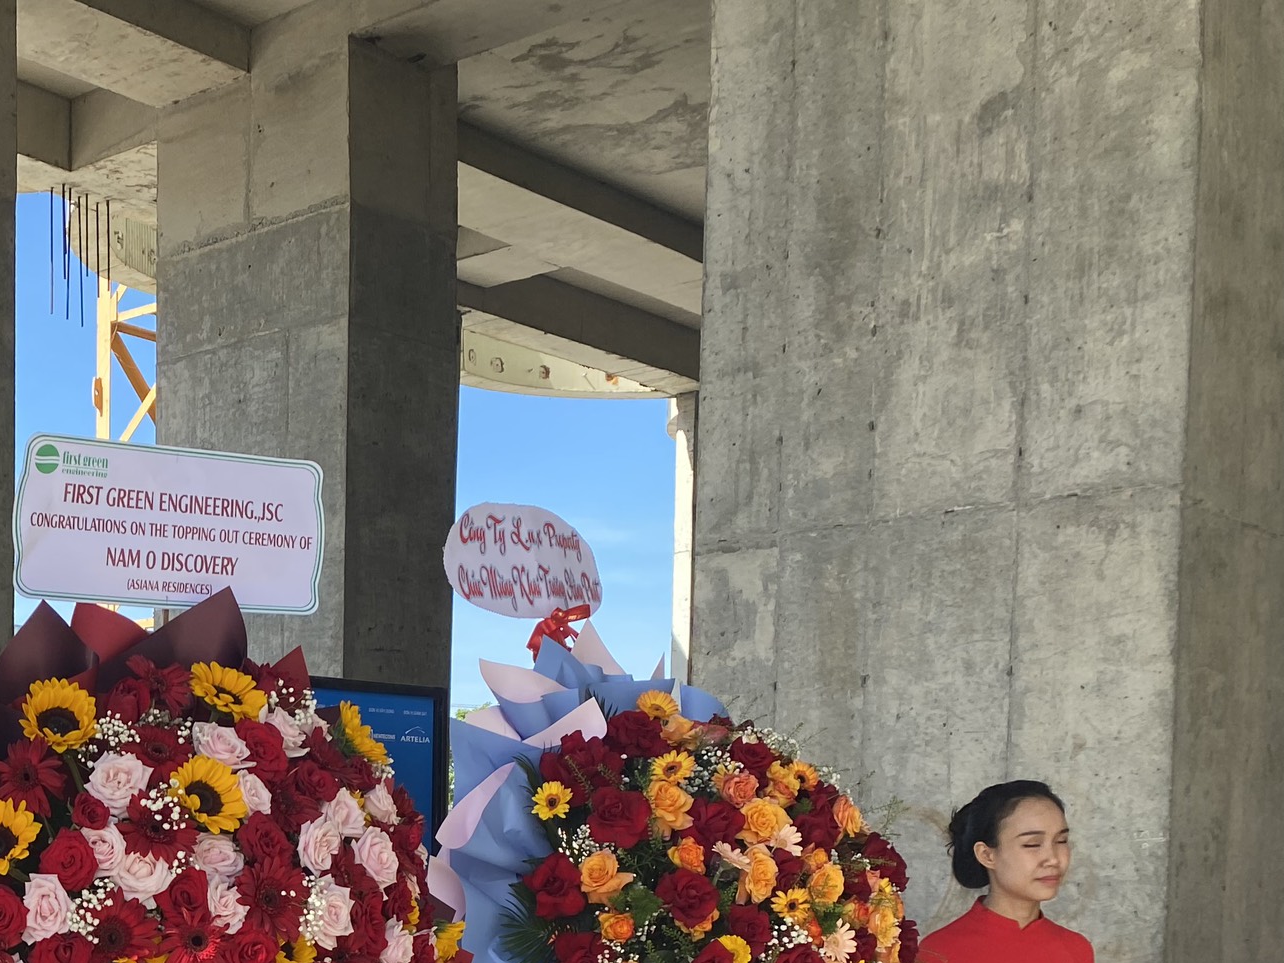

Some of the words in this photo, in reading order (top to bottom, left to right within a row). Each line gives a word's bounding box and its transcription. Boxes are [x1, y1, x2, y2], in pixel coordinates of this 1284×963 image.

[62, 450, 82, 466] first
[83, 455, 109, 469] green
[61, 467, 109, 478] engineering
[63, 482, 104, 506] FIRST
[106, 488, 155, 511] GREEN
[29, 511, 128, 535] CONGRATULATIONS
[129, 520, 147, 537] ON
[148, 522, 169, 538] THE
[171, 524, 217, 543] TOPPING
[219, 527, 241, 545] OUT
[242, 530, 299, 550] CEREMONY
[299, 536, 313, 551] OF
[486, 514, 506, 556] Ty
[105, 546, 142, 569] NAM
[145, 550, 157, 571] O
[160, 551, 240, 577] DISCOVERY
[126, 577, 160, 593] (ASIANA
[161, 580, 214, 597] RESIDENCES)
[400, 735, 431, 744] ARTELIA
